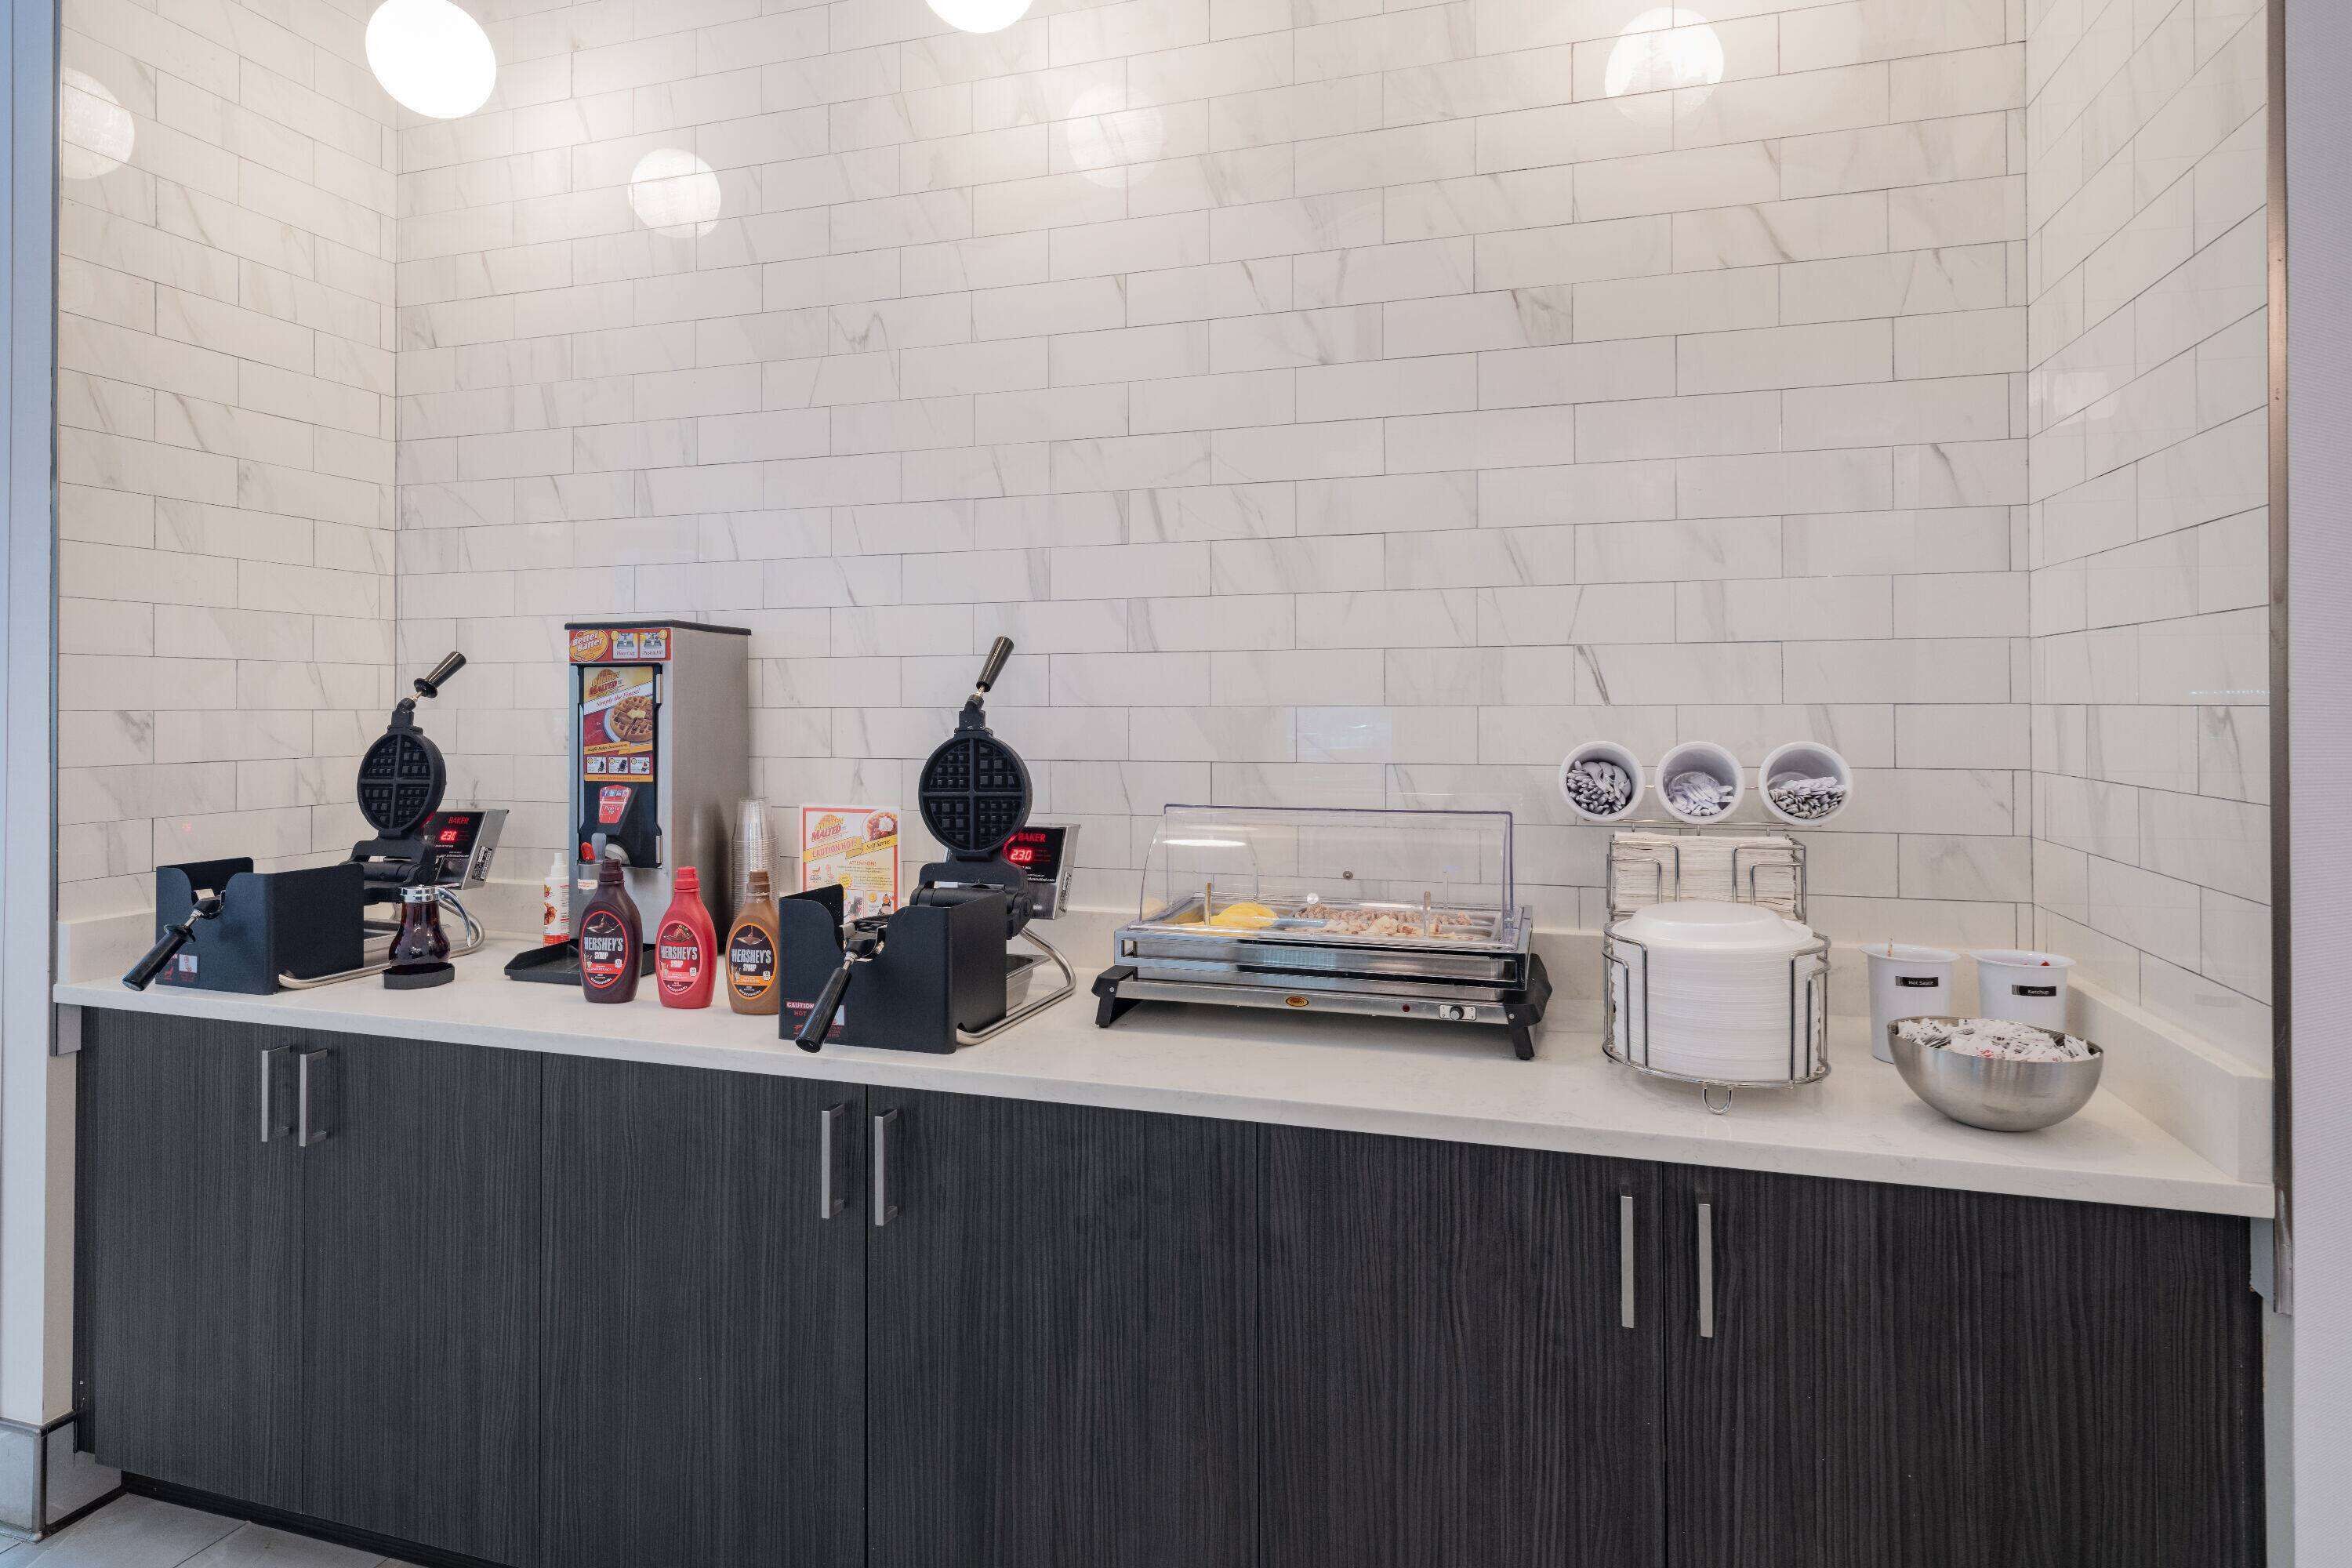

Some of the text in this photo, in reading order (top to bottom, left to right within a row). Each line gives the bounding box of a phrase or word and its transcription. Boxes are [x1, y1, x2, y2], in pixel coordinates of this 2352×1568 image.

[590, 680, 618, 695] MALTED
[811, 824, 841, 840] MALTED
[812, 844, 840, 858] CAUTION
[583, 936, 623, 952] HERSHEY'S
[660, 945, 698, 960] HERSHEY'S
[731, 948, 771, 964] HERSHEY'S
